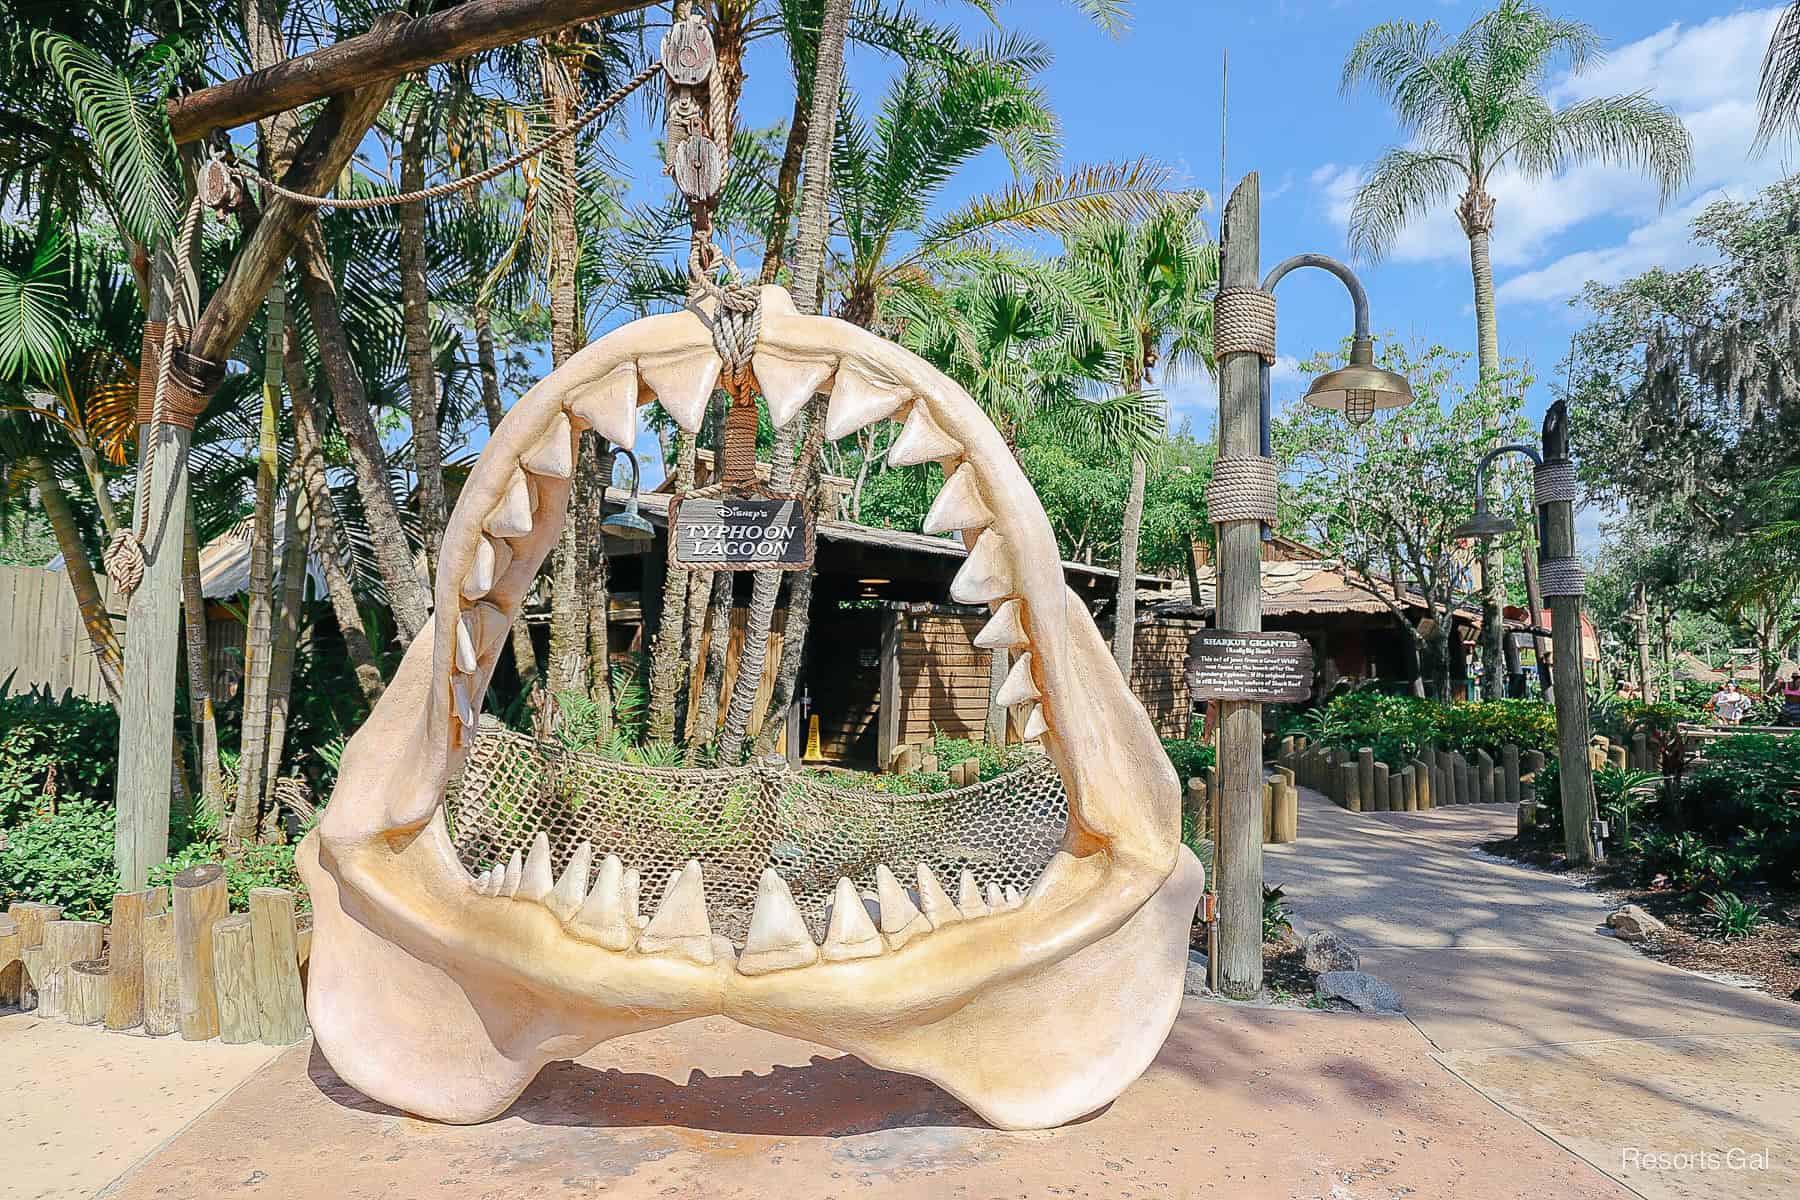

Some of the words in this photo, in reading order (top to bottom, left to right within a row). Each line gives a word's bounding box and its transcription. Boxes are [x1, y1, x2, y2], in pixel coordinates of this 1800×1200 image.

[686, 525, 797, 539] TYPHOON
[692, 542, 789, 556] LAGOON
[1203, 638, 1246, 646] SHARKUS
[1249, 639, 1297, 648] GIGANTUS
